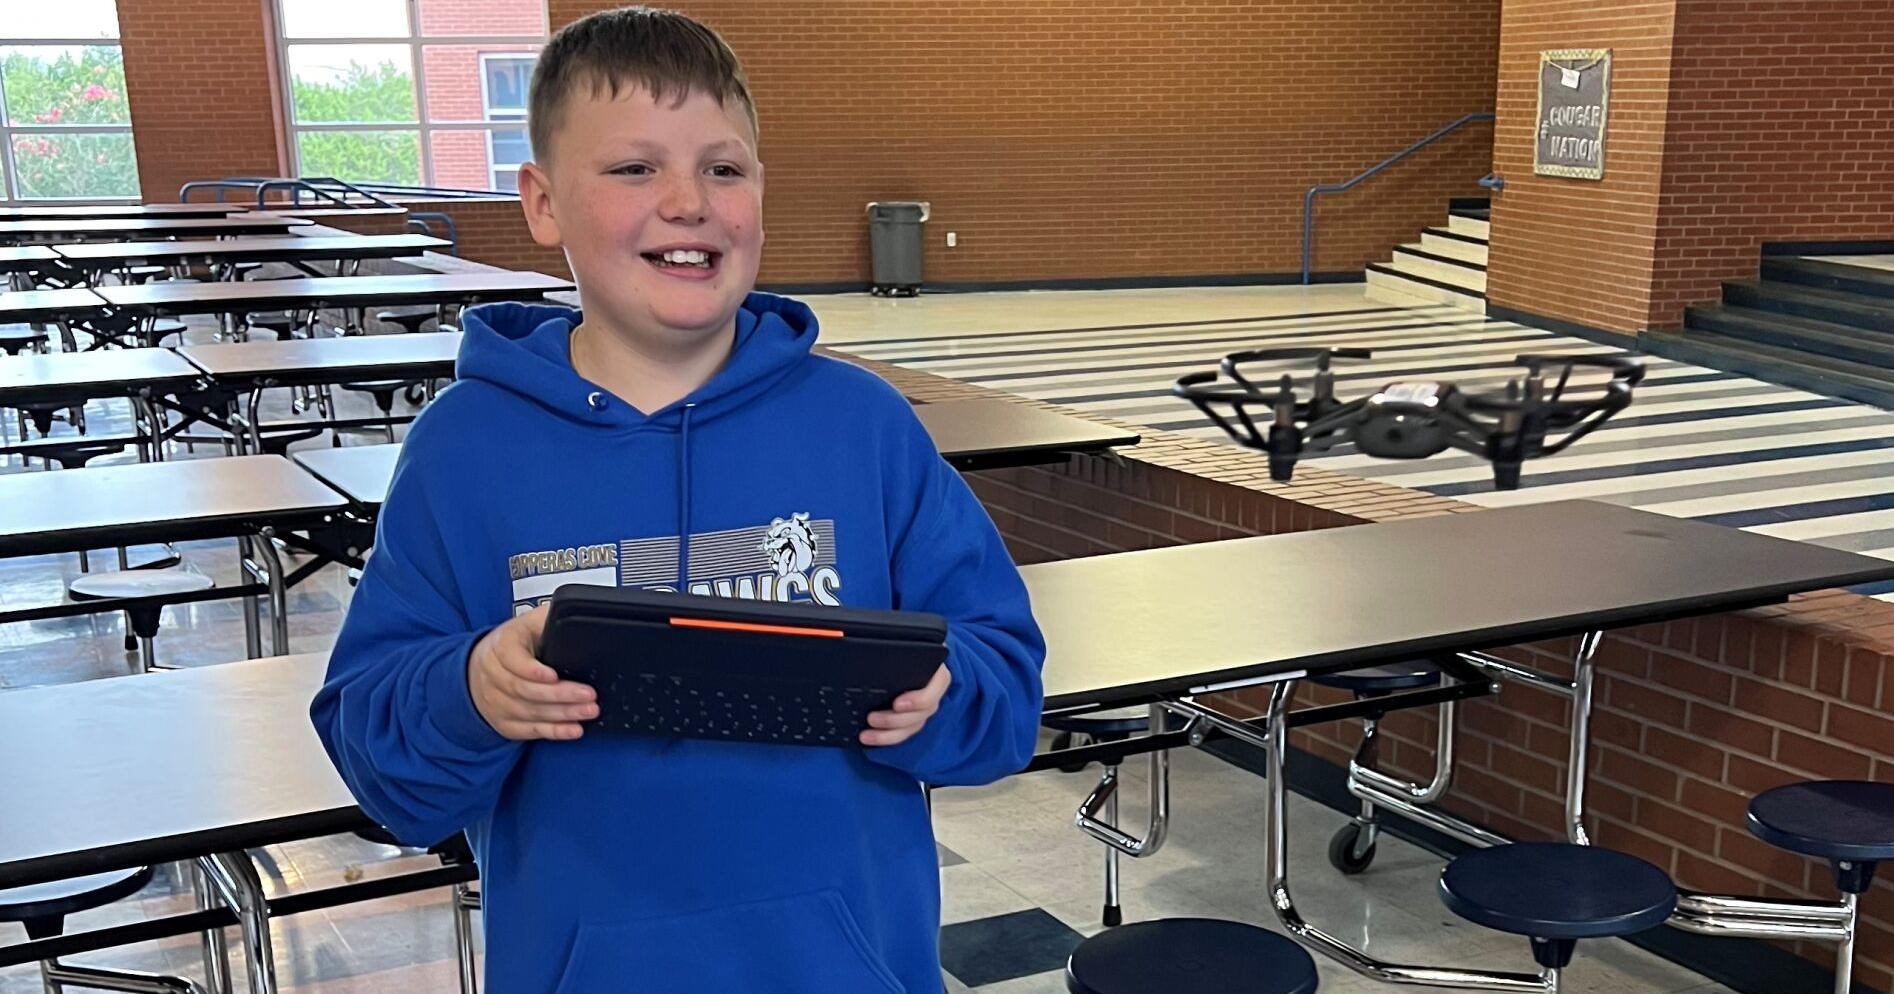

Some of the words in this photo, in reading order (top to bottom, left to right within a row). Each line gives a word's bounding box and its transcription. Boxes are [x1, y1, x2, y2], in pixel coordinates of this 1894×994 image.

[1551, 106, 1600, 126] COUGAR
[1551, 136, 1602, 161] NATION
[577, 543, 618, 569] COVE
